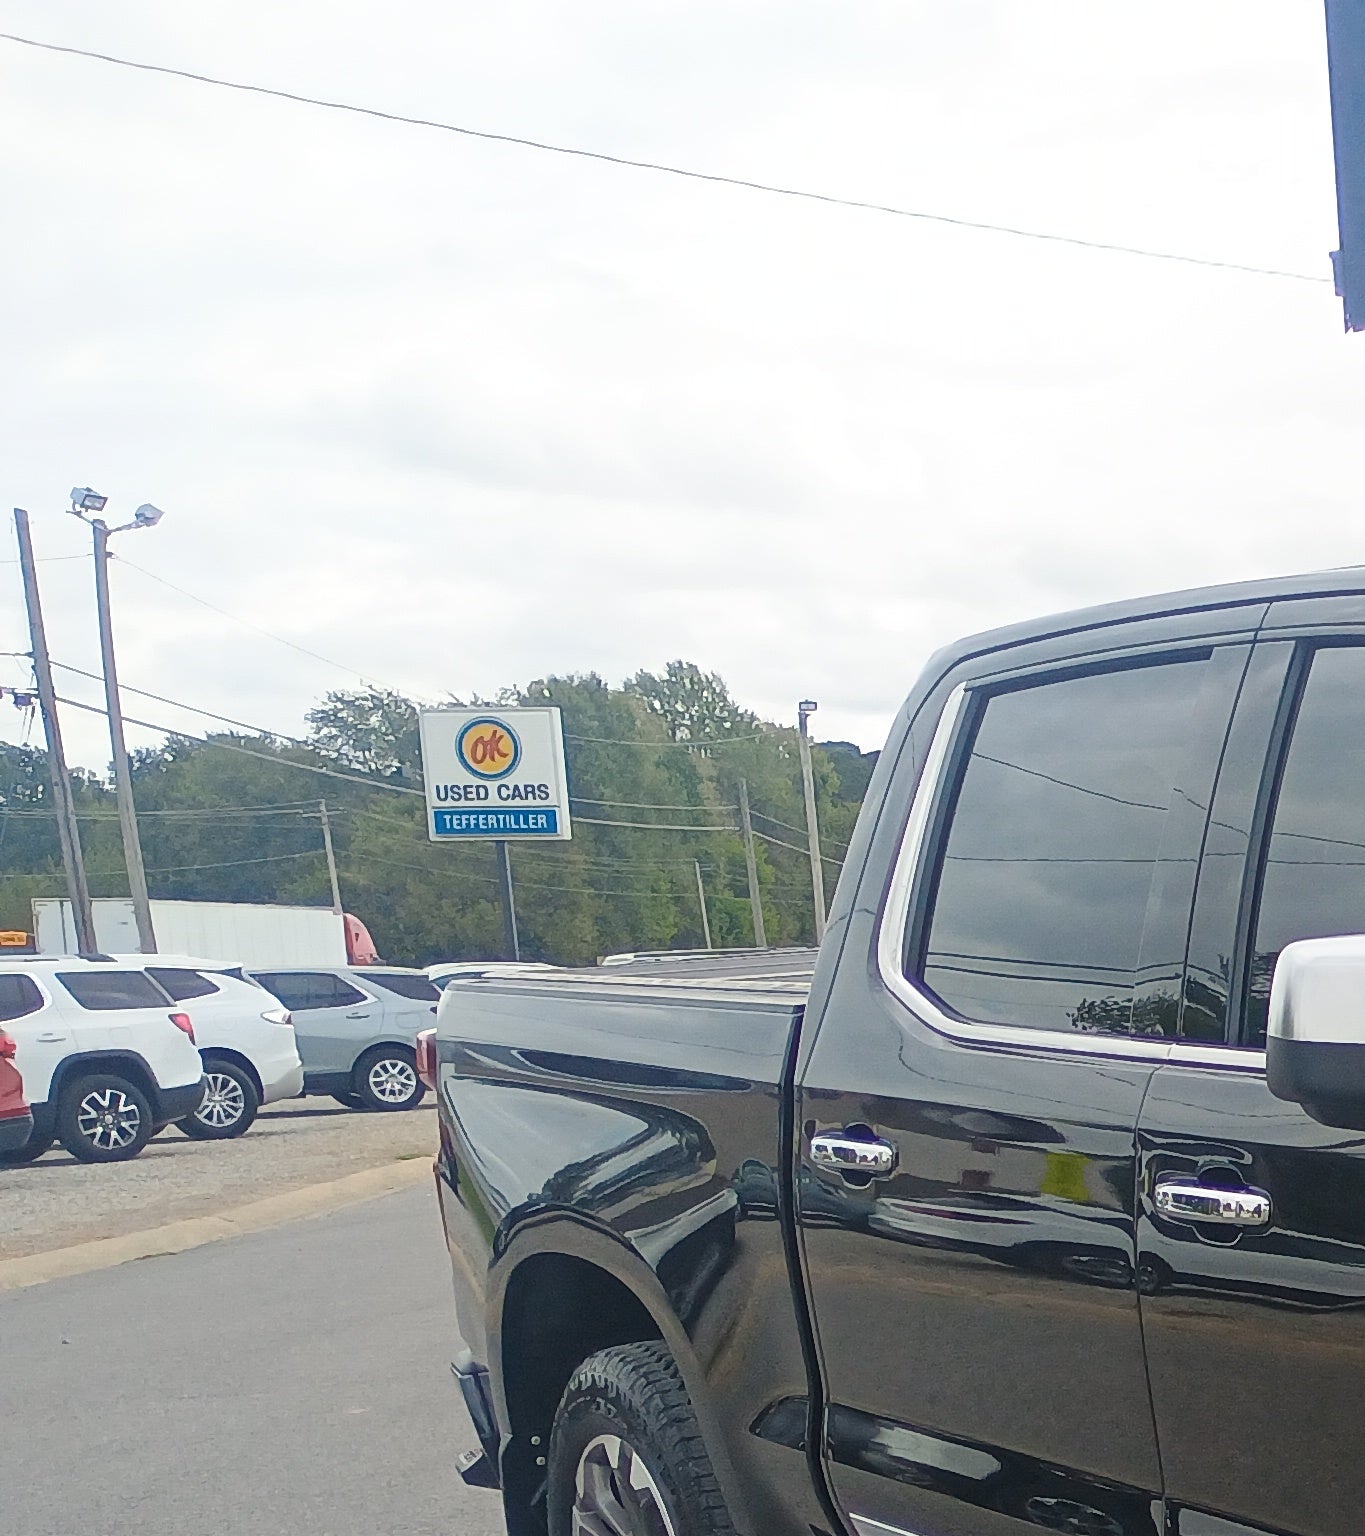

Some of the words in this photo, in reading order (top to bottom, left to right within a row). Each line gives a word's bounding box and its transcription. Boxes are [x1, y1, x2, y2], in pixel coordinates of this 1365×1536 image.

[470, 729, 509, 765] OK
[435, 784, 489, 801] USED
[497, 783, 550, 801] CARS
[443, 813, 547, 830] TEFFERTILLER
